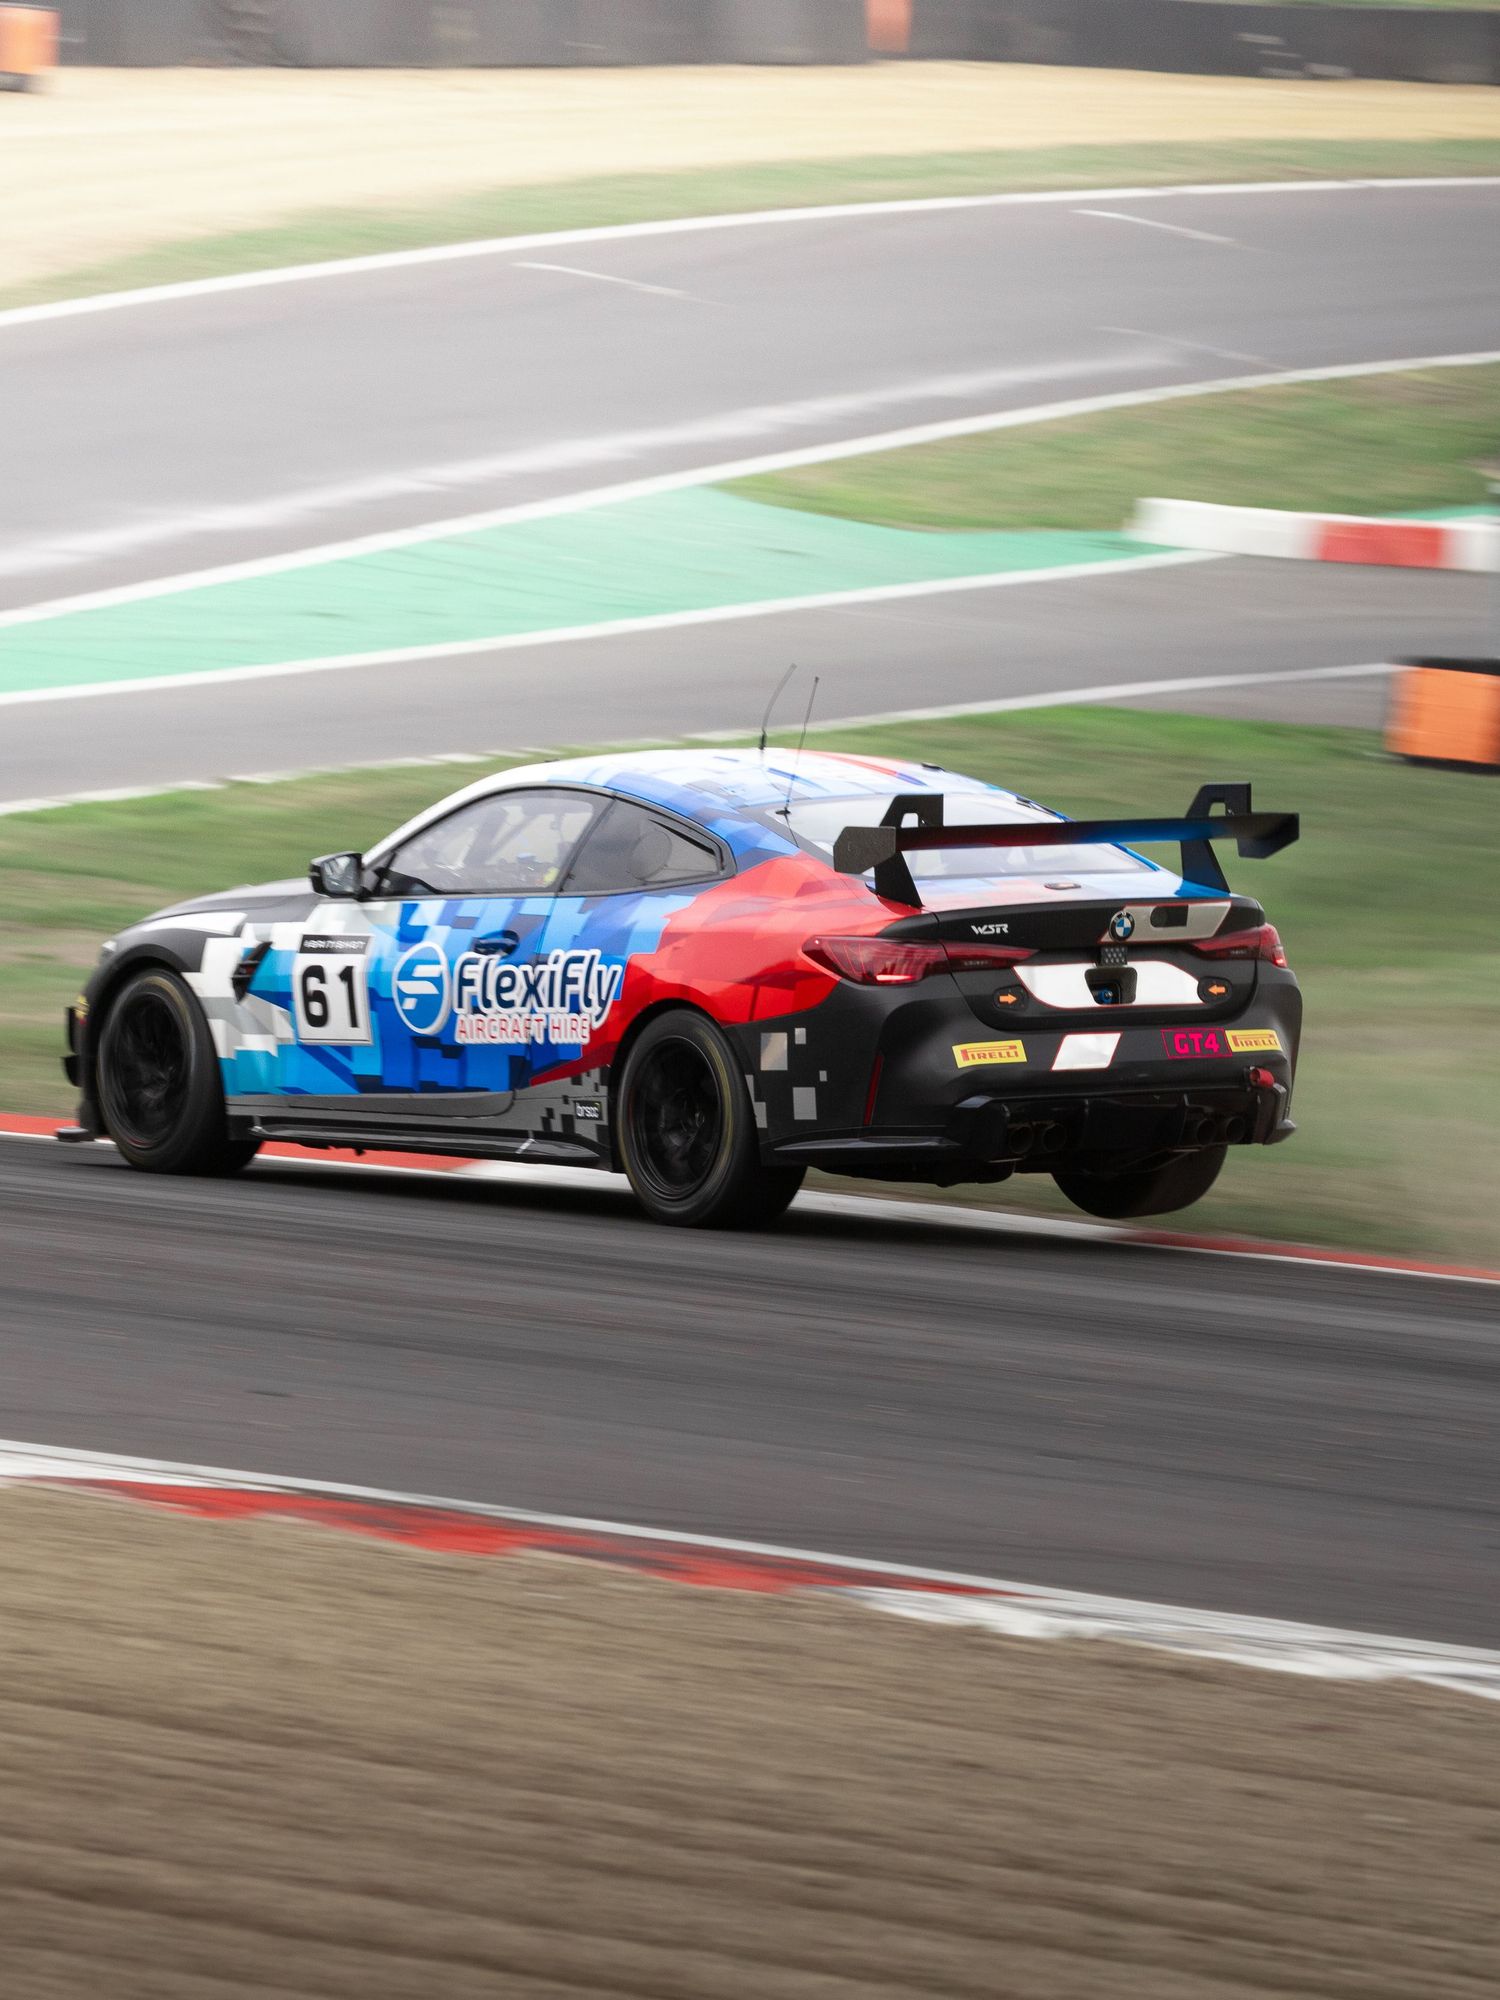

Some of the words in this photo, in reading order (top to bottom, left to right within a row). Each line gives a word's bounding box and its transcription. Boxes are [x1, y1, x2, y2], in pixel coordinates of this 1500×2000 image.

[971, 923, 1009, 935] WSR
[301, 964, 360, 1029] 61
[458, 1017, 544, 1041] AIRCRAFT
[551, 1017, 590, 1041] HIRE
[1174, 1032, 1220, 1055] GT4
[1231, 1033, 1278, 1049] PIRELLI
[960, 1044, 1020, 1062] PIRELLI
